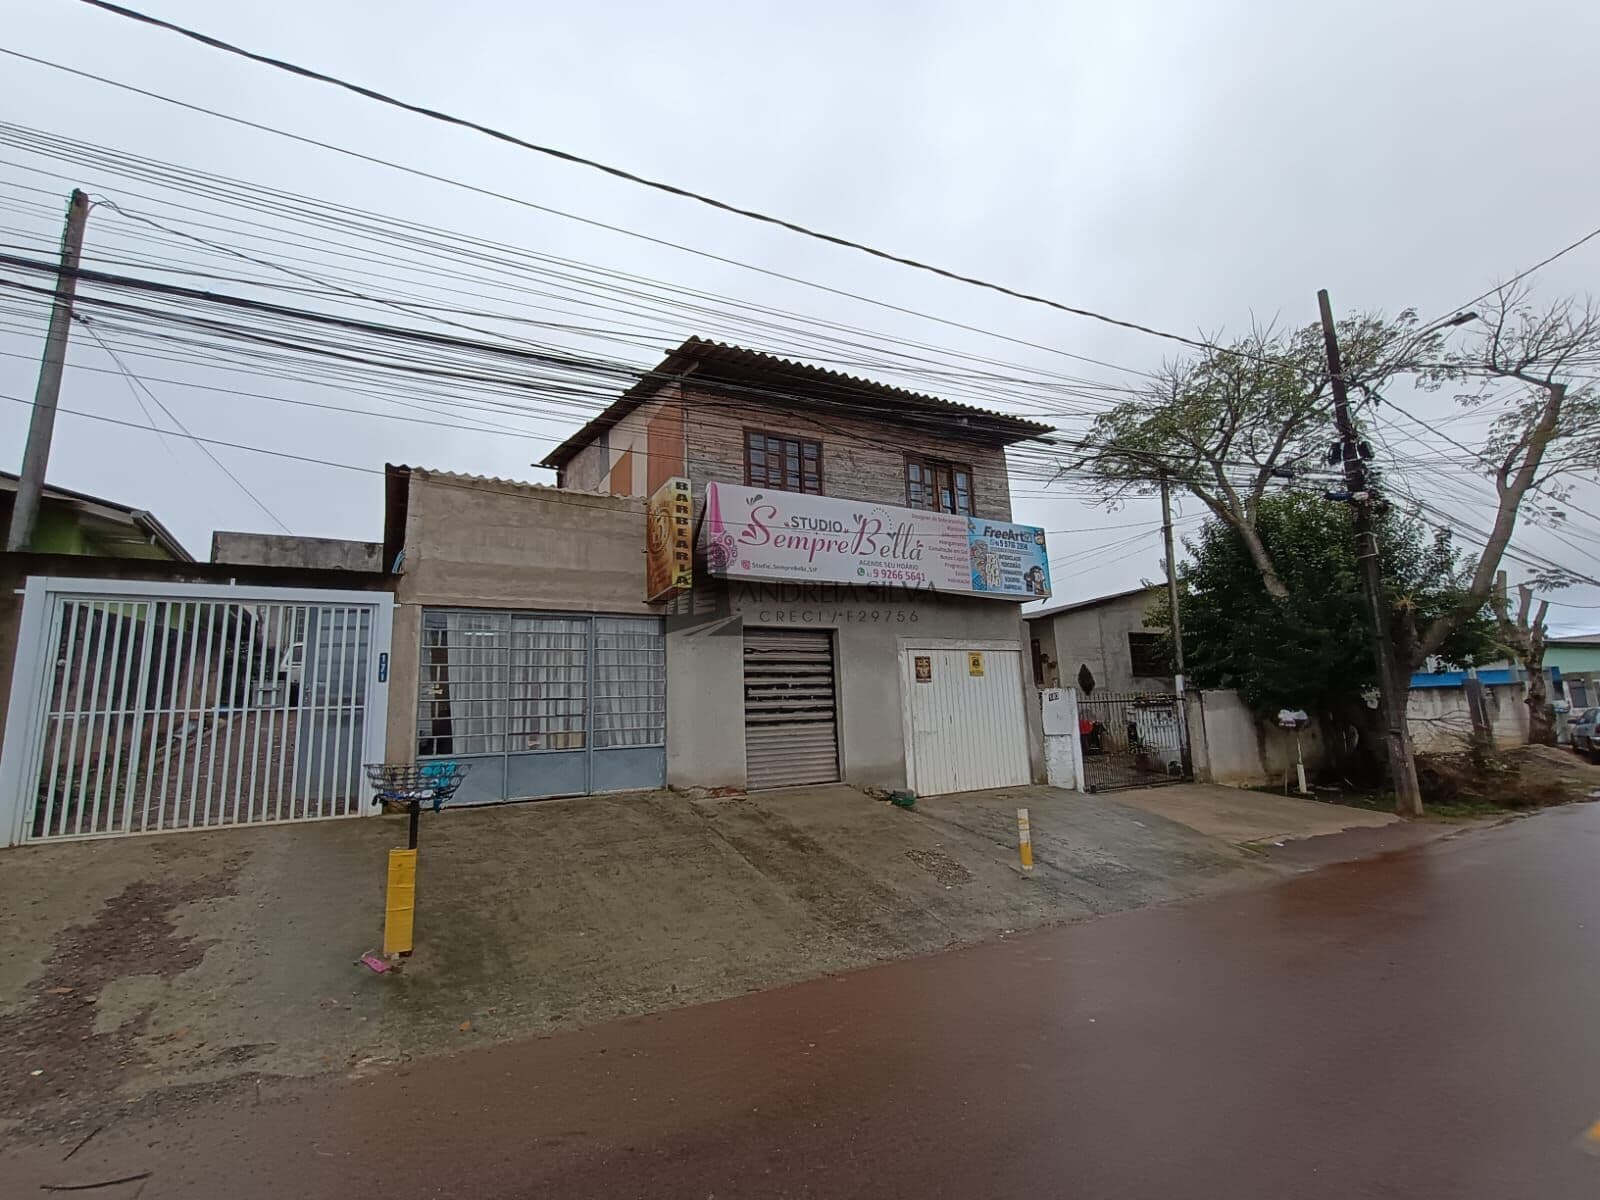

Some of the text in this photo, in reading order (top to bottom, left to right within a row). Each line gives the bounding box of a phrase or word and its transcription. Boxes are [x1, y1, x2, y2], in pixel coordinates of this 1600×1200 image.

[790, 515, 843, 533] STUDIO
[675, 481, 689, 586] BARBEARIA
[737, 505, 923, 563] Sempre Bella
[984, 526, 1024, 542] FreeArt
[884, 561, 896, 569] SEU
[873, 568, 879, 578] 9
[881, 569, 904, 580] 9266
[905, 571, 926, 582] 5641
